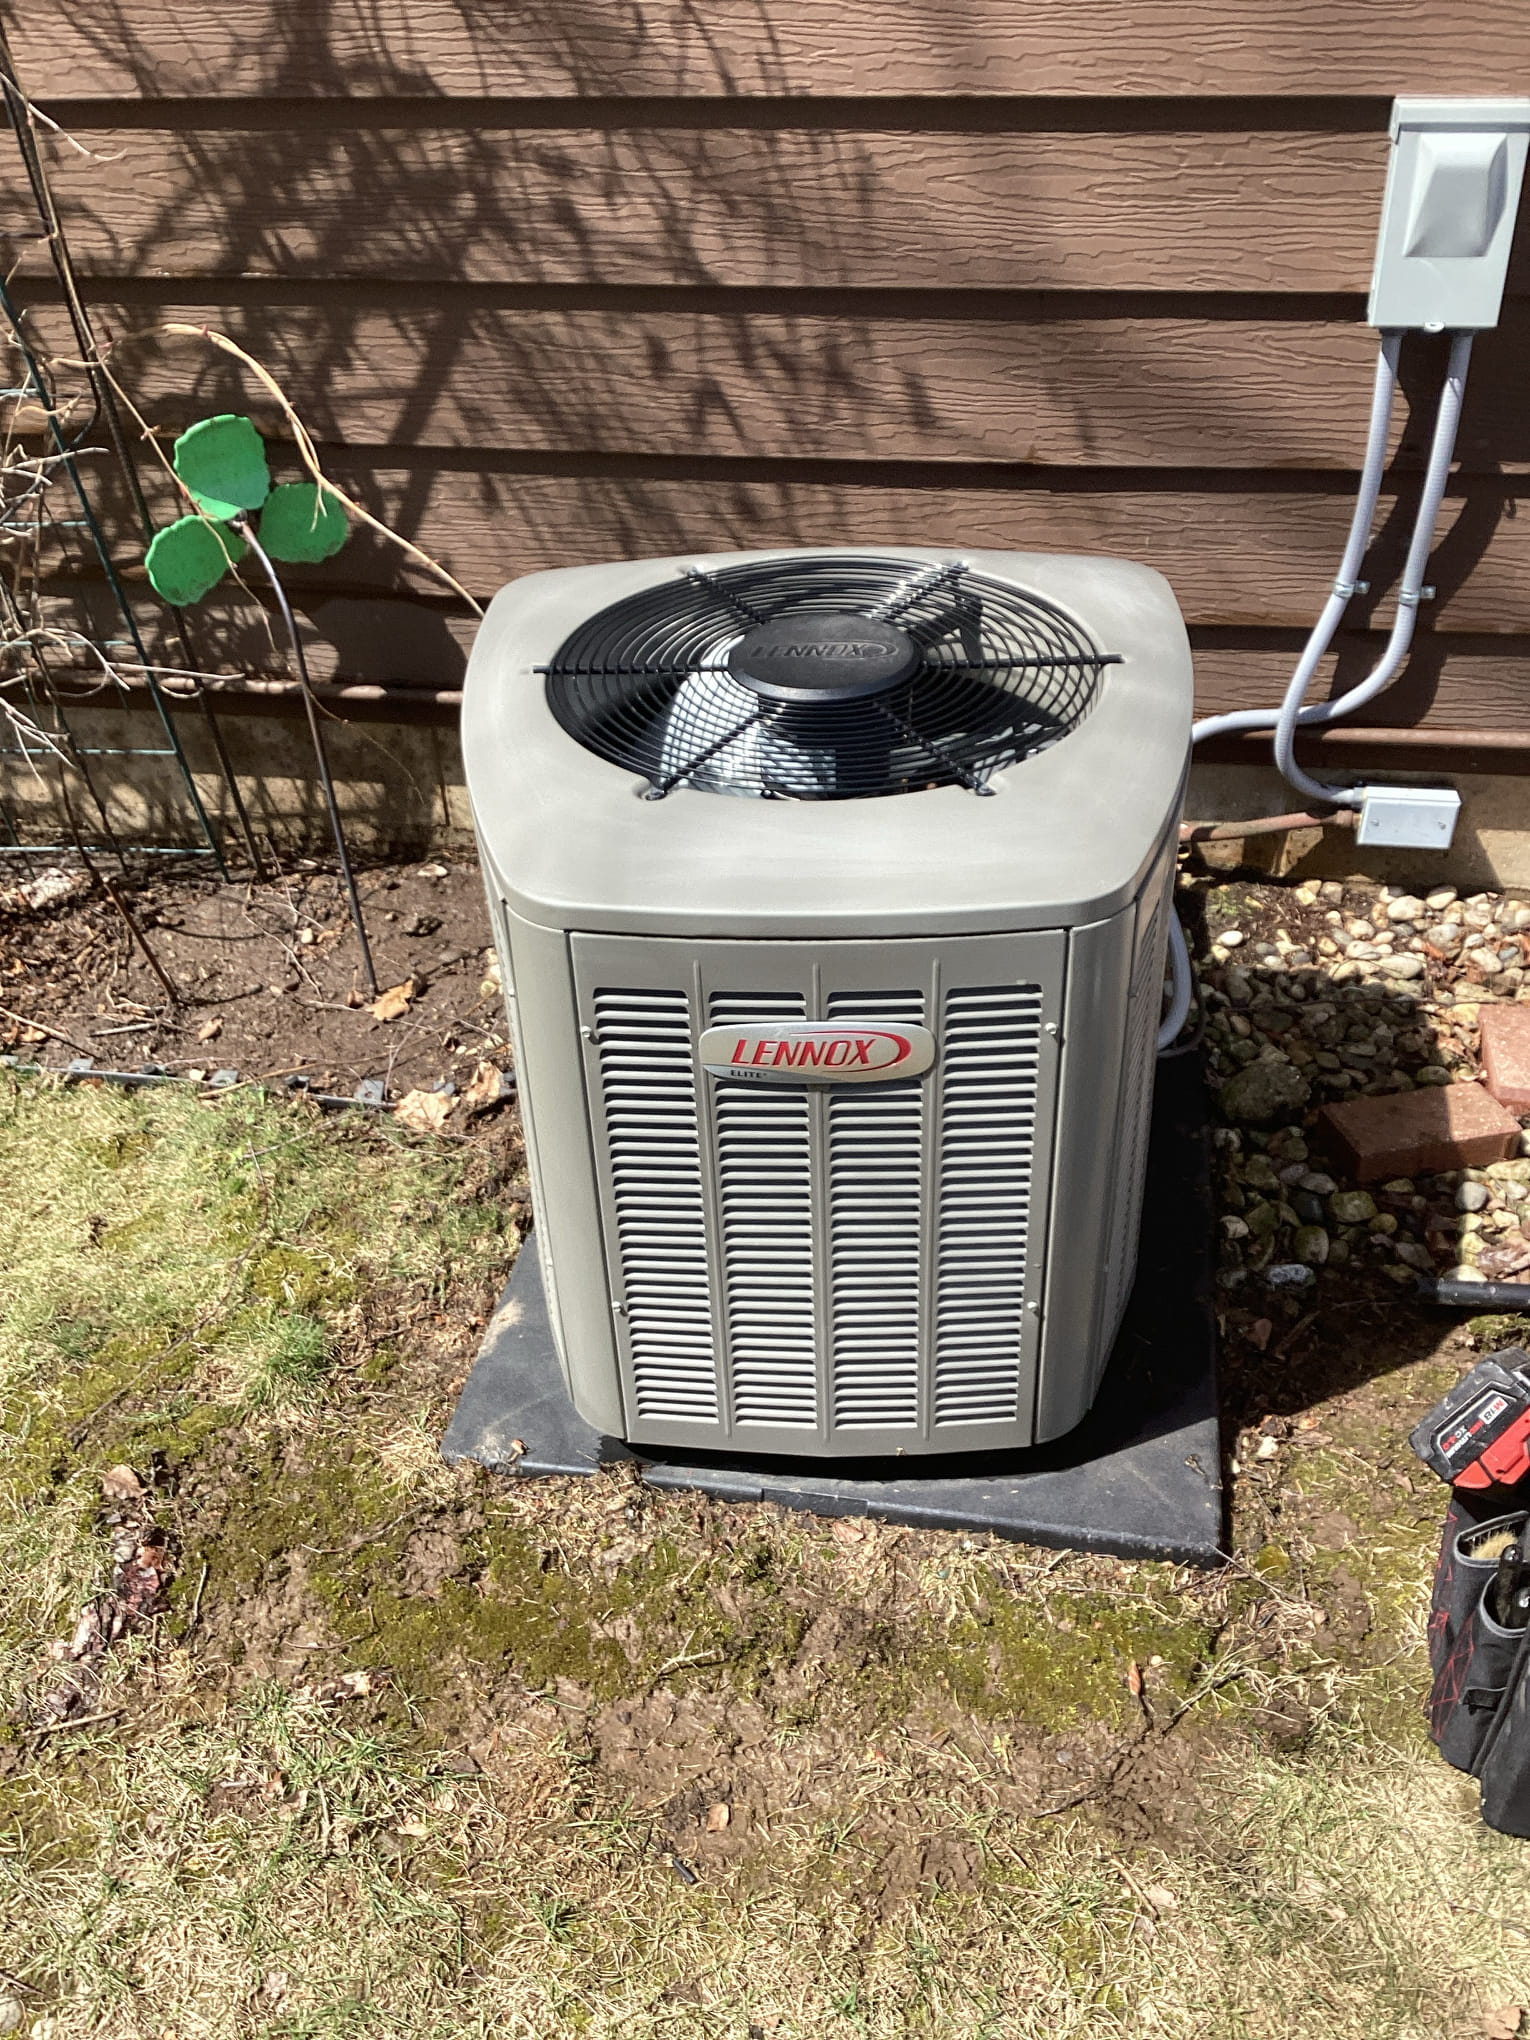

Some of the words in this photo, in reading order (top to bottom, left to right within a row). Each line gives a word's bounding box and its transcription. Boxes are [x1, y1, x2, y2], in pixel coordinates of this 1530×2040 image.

[751, 644, 865, 657] LENNOX
[731, 1038, 876, 1066] LENNOX
[1483, 1399, 1505, 1421] M18
